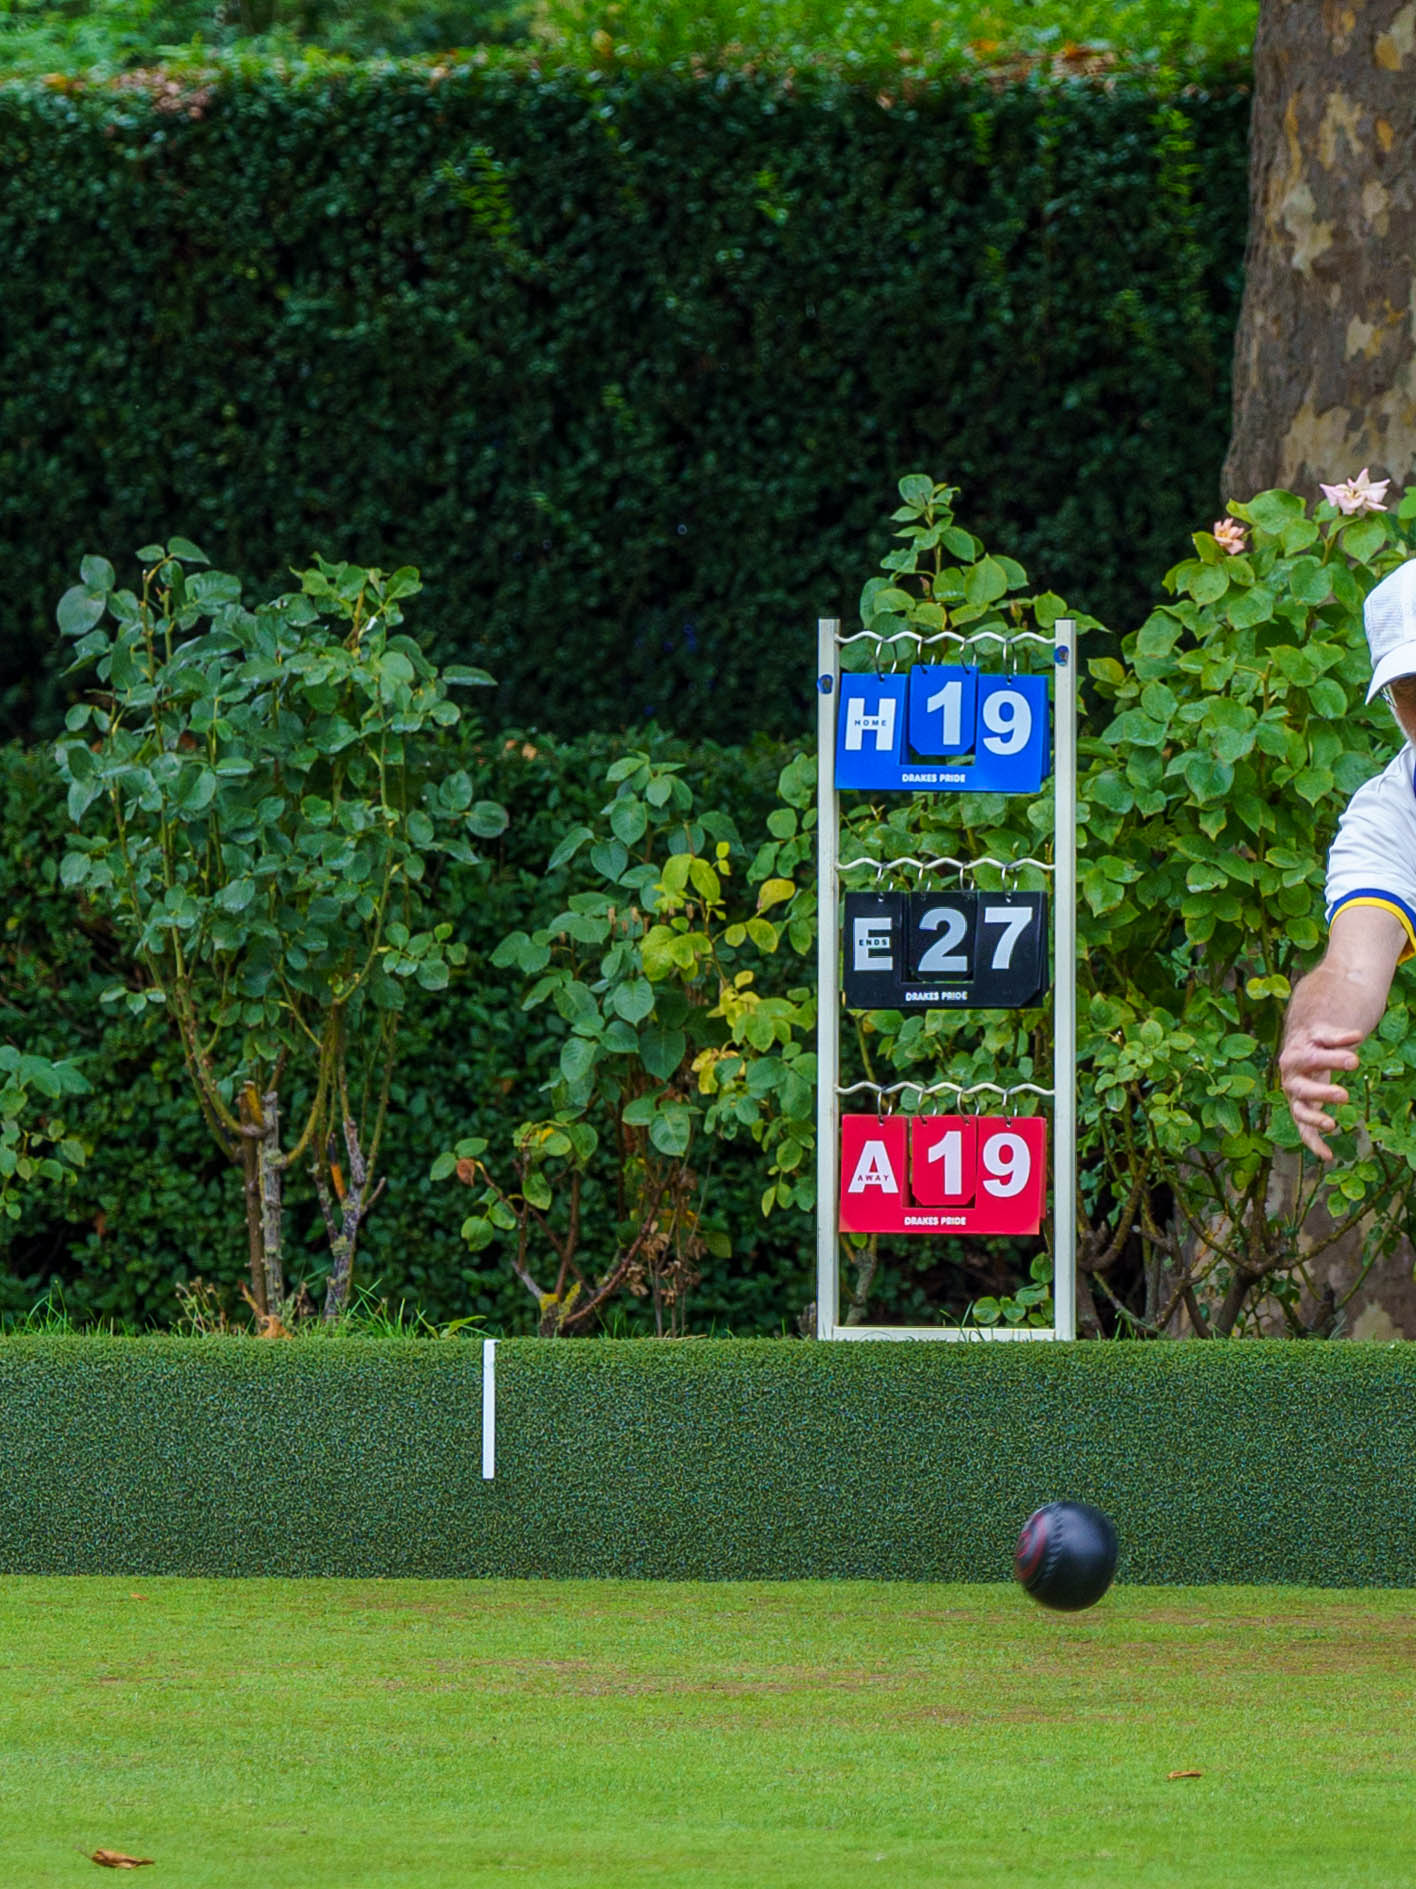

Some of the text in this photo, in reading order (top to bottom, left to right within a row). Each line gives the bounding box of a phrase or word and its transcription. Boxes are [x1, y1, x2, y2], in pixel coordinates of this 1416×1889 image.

[845, 681, 1032, 756] H 19
[854, 719, 887, 727] HOME
[902, 773, 966, 784] DRAKES PRIDE
[853, 906, 1033, 972] E 27
[858, 939, 888, 947] ENDS
[905, 991, 968, 1001] DRAKES PRIDE
[848, 1130, 1031, 1198] A 19
[857, 1174, 889, 1182] AWAY
[904, 1216, 967, 1226] DRAKES PRIDE
